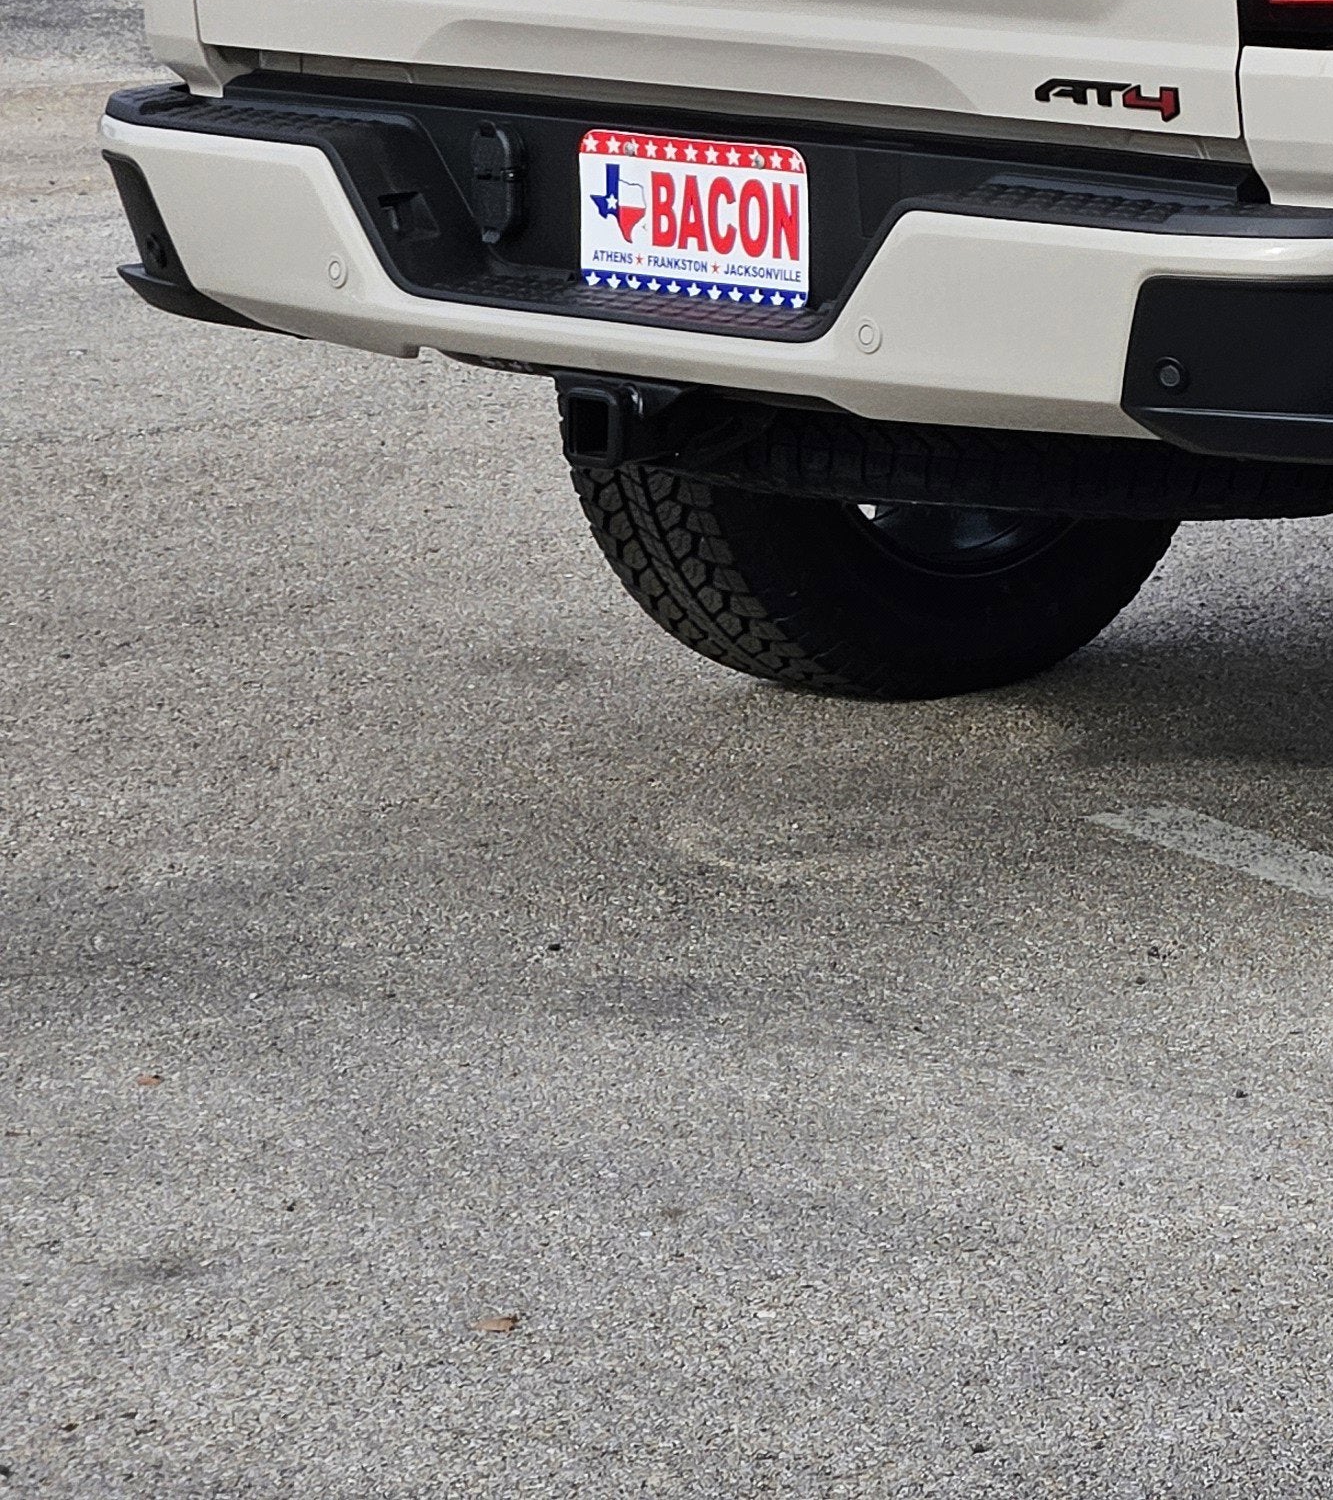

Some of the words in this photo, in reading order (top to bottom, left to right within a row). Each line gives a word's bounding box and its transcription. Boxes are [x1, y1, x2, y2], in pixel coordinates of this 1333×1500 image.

[1034, 77, 1181, 123] AT4
[650, 170, 800, 262] BACON
[592, 249, 633, 265] ATHENS
[647, 254, 708, 273] FRANKSTON
[723, 263, 802, 283] JACKSONVILLE
